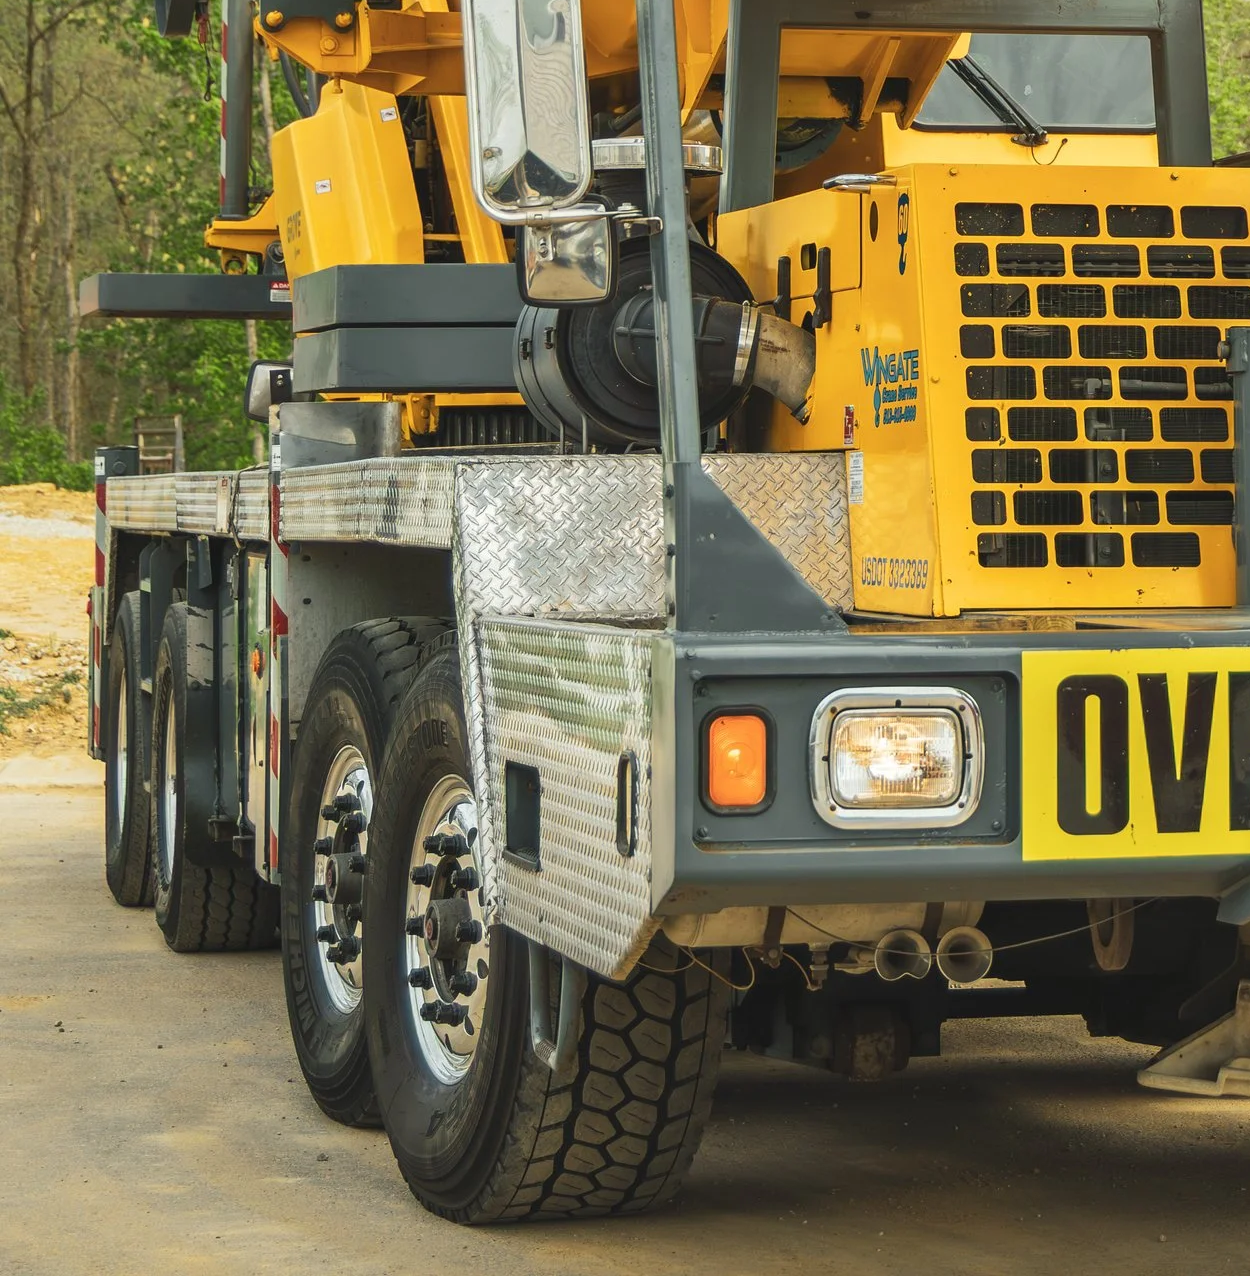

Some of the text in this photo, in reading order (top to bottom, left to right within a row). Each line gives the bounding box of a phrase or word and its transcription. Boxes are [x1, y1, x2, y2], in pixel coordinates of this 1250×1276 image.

[899, 203, 909, 235] 60
[861, 346, 919, 386] WINGATE
[861, 556, 887, 586] USDOT
